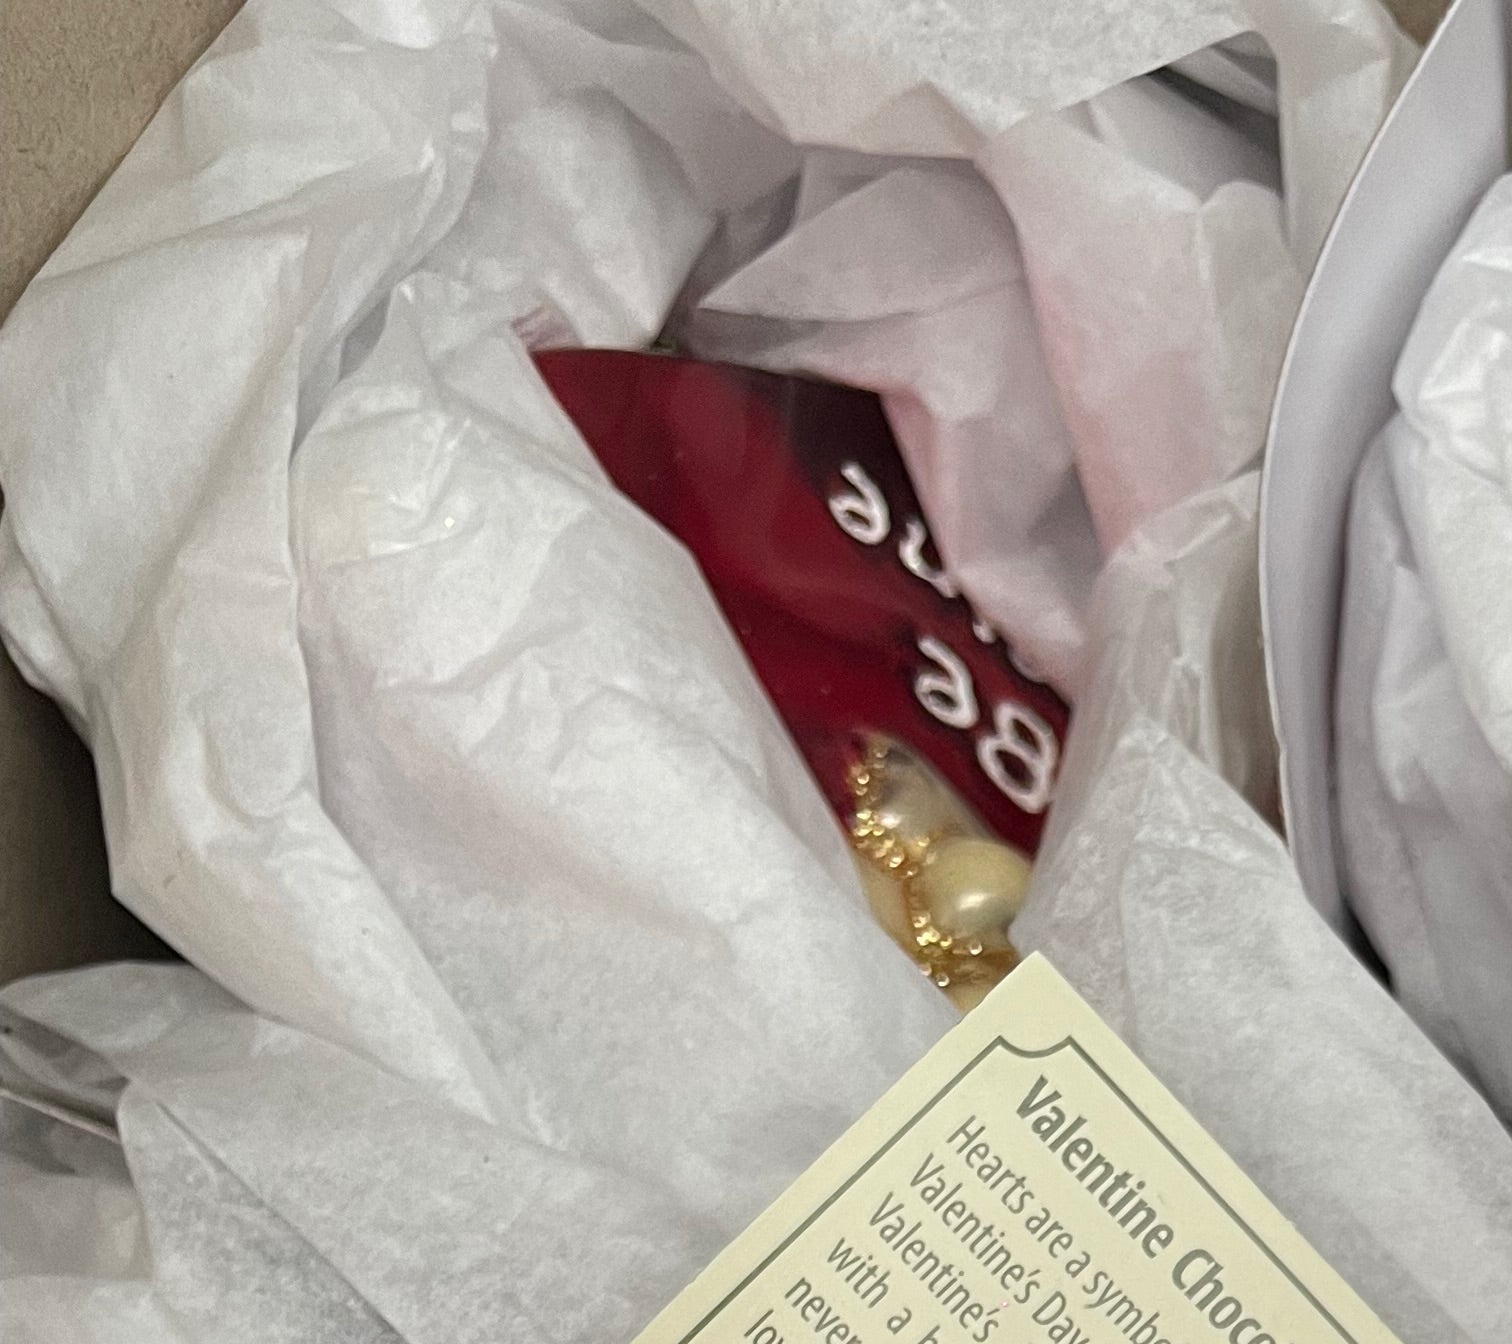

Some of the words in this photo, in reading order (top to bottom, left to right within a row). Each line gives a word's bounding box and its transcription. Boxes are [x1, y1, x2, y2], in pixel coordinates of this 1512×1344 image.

[914, 636, 1059, 814] Be
[909, 1151, 1043, 1304] Valentine's
[945, 1114, 1035, 1215] Hearts
[1024, 1207, 1074, 1260] are
[1064, 1250, 1091, 1279] a
[1015, 1073, 1175, 1259] Valentine
[826, 1236, 891, 1309] with
[886, 1306, 913, 1336] a
[868, 1190, 1001, 1343] Valentine's
